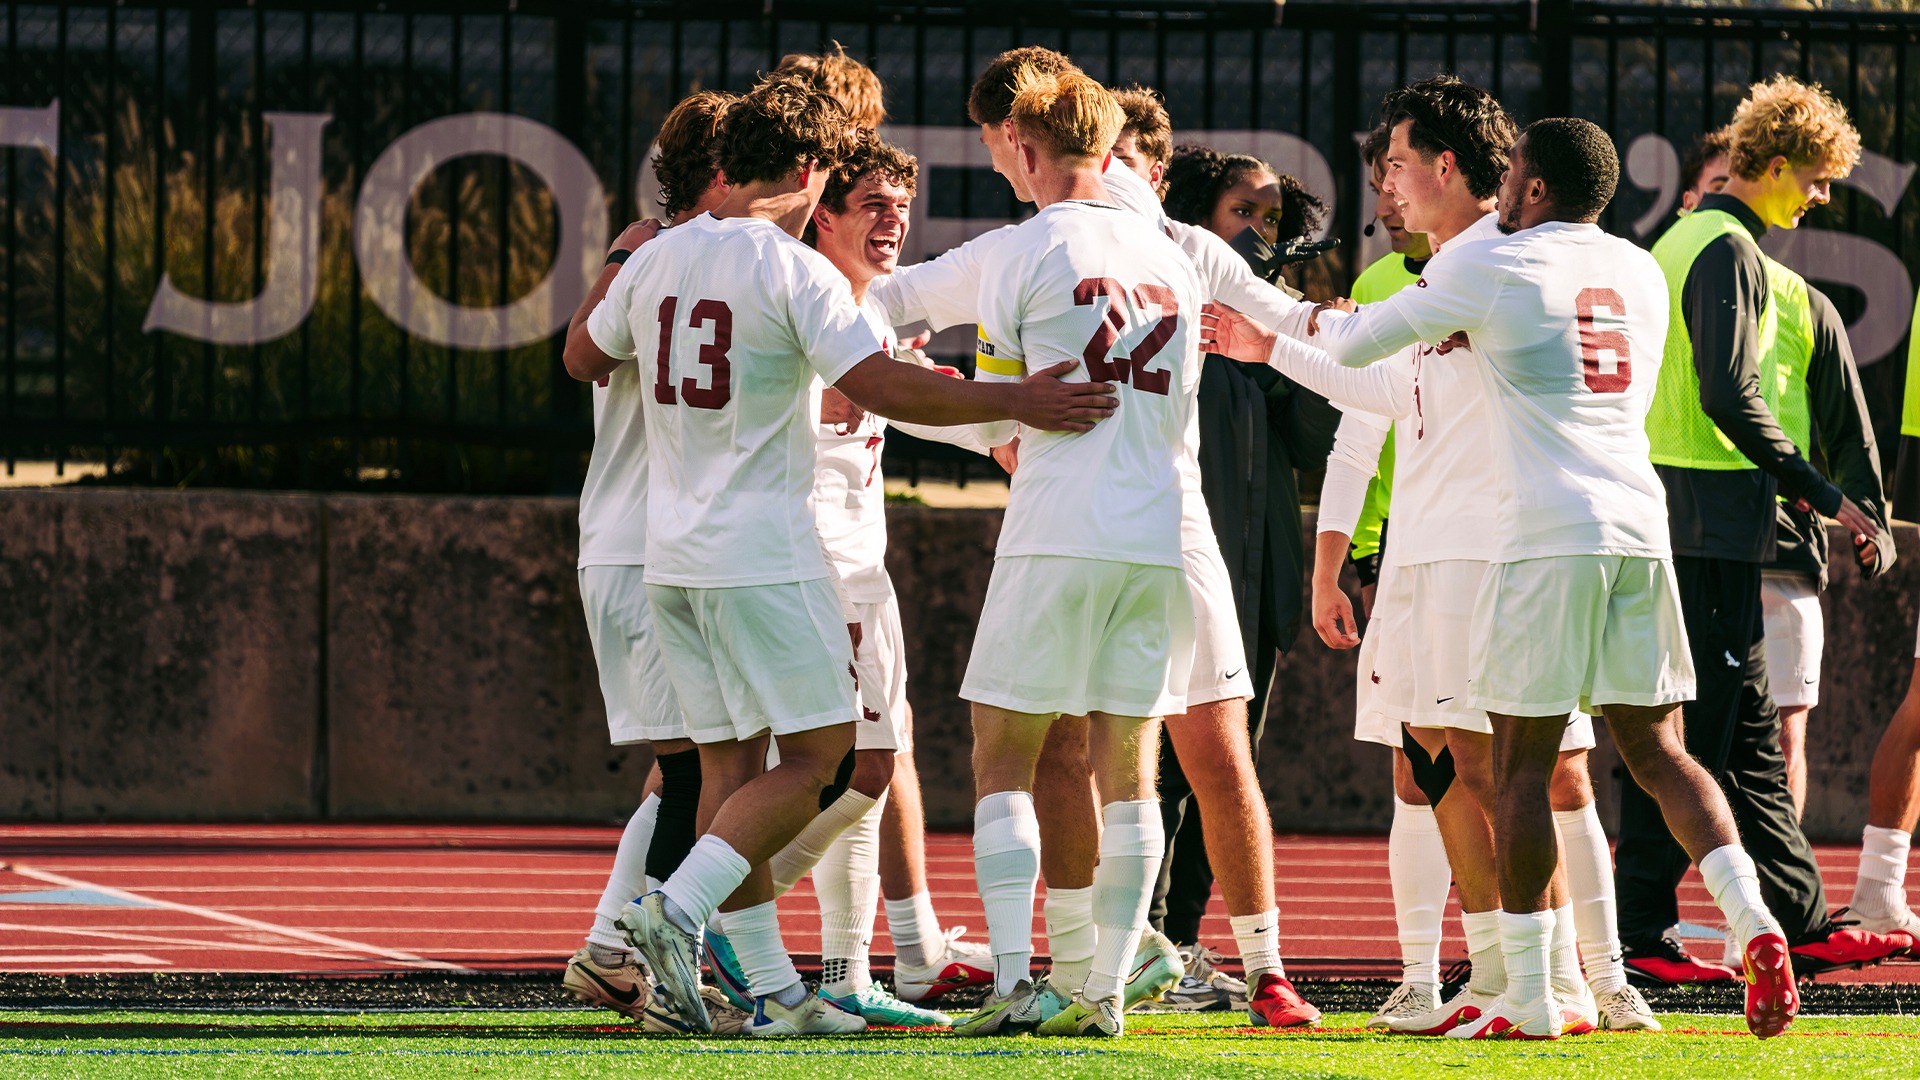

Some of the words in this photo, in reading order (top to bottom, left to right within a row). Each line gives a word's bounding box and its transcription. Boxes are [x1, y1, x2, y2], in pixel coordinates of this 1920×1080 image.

[654, 296, 732, 409] 13
[977, 338, 996, 357] TAIN
[1073, 277, 1179, 395] 22
[1575, 288, 1632, 393] 6
